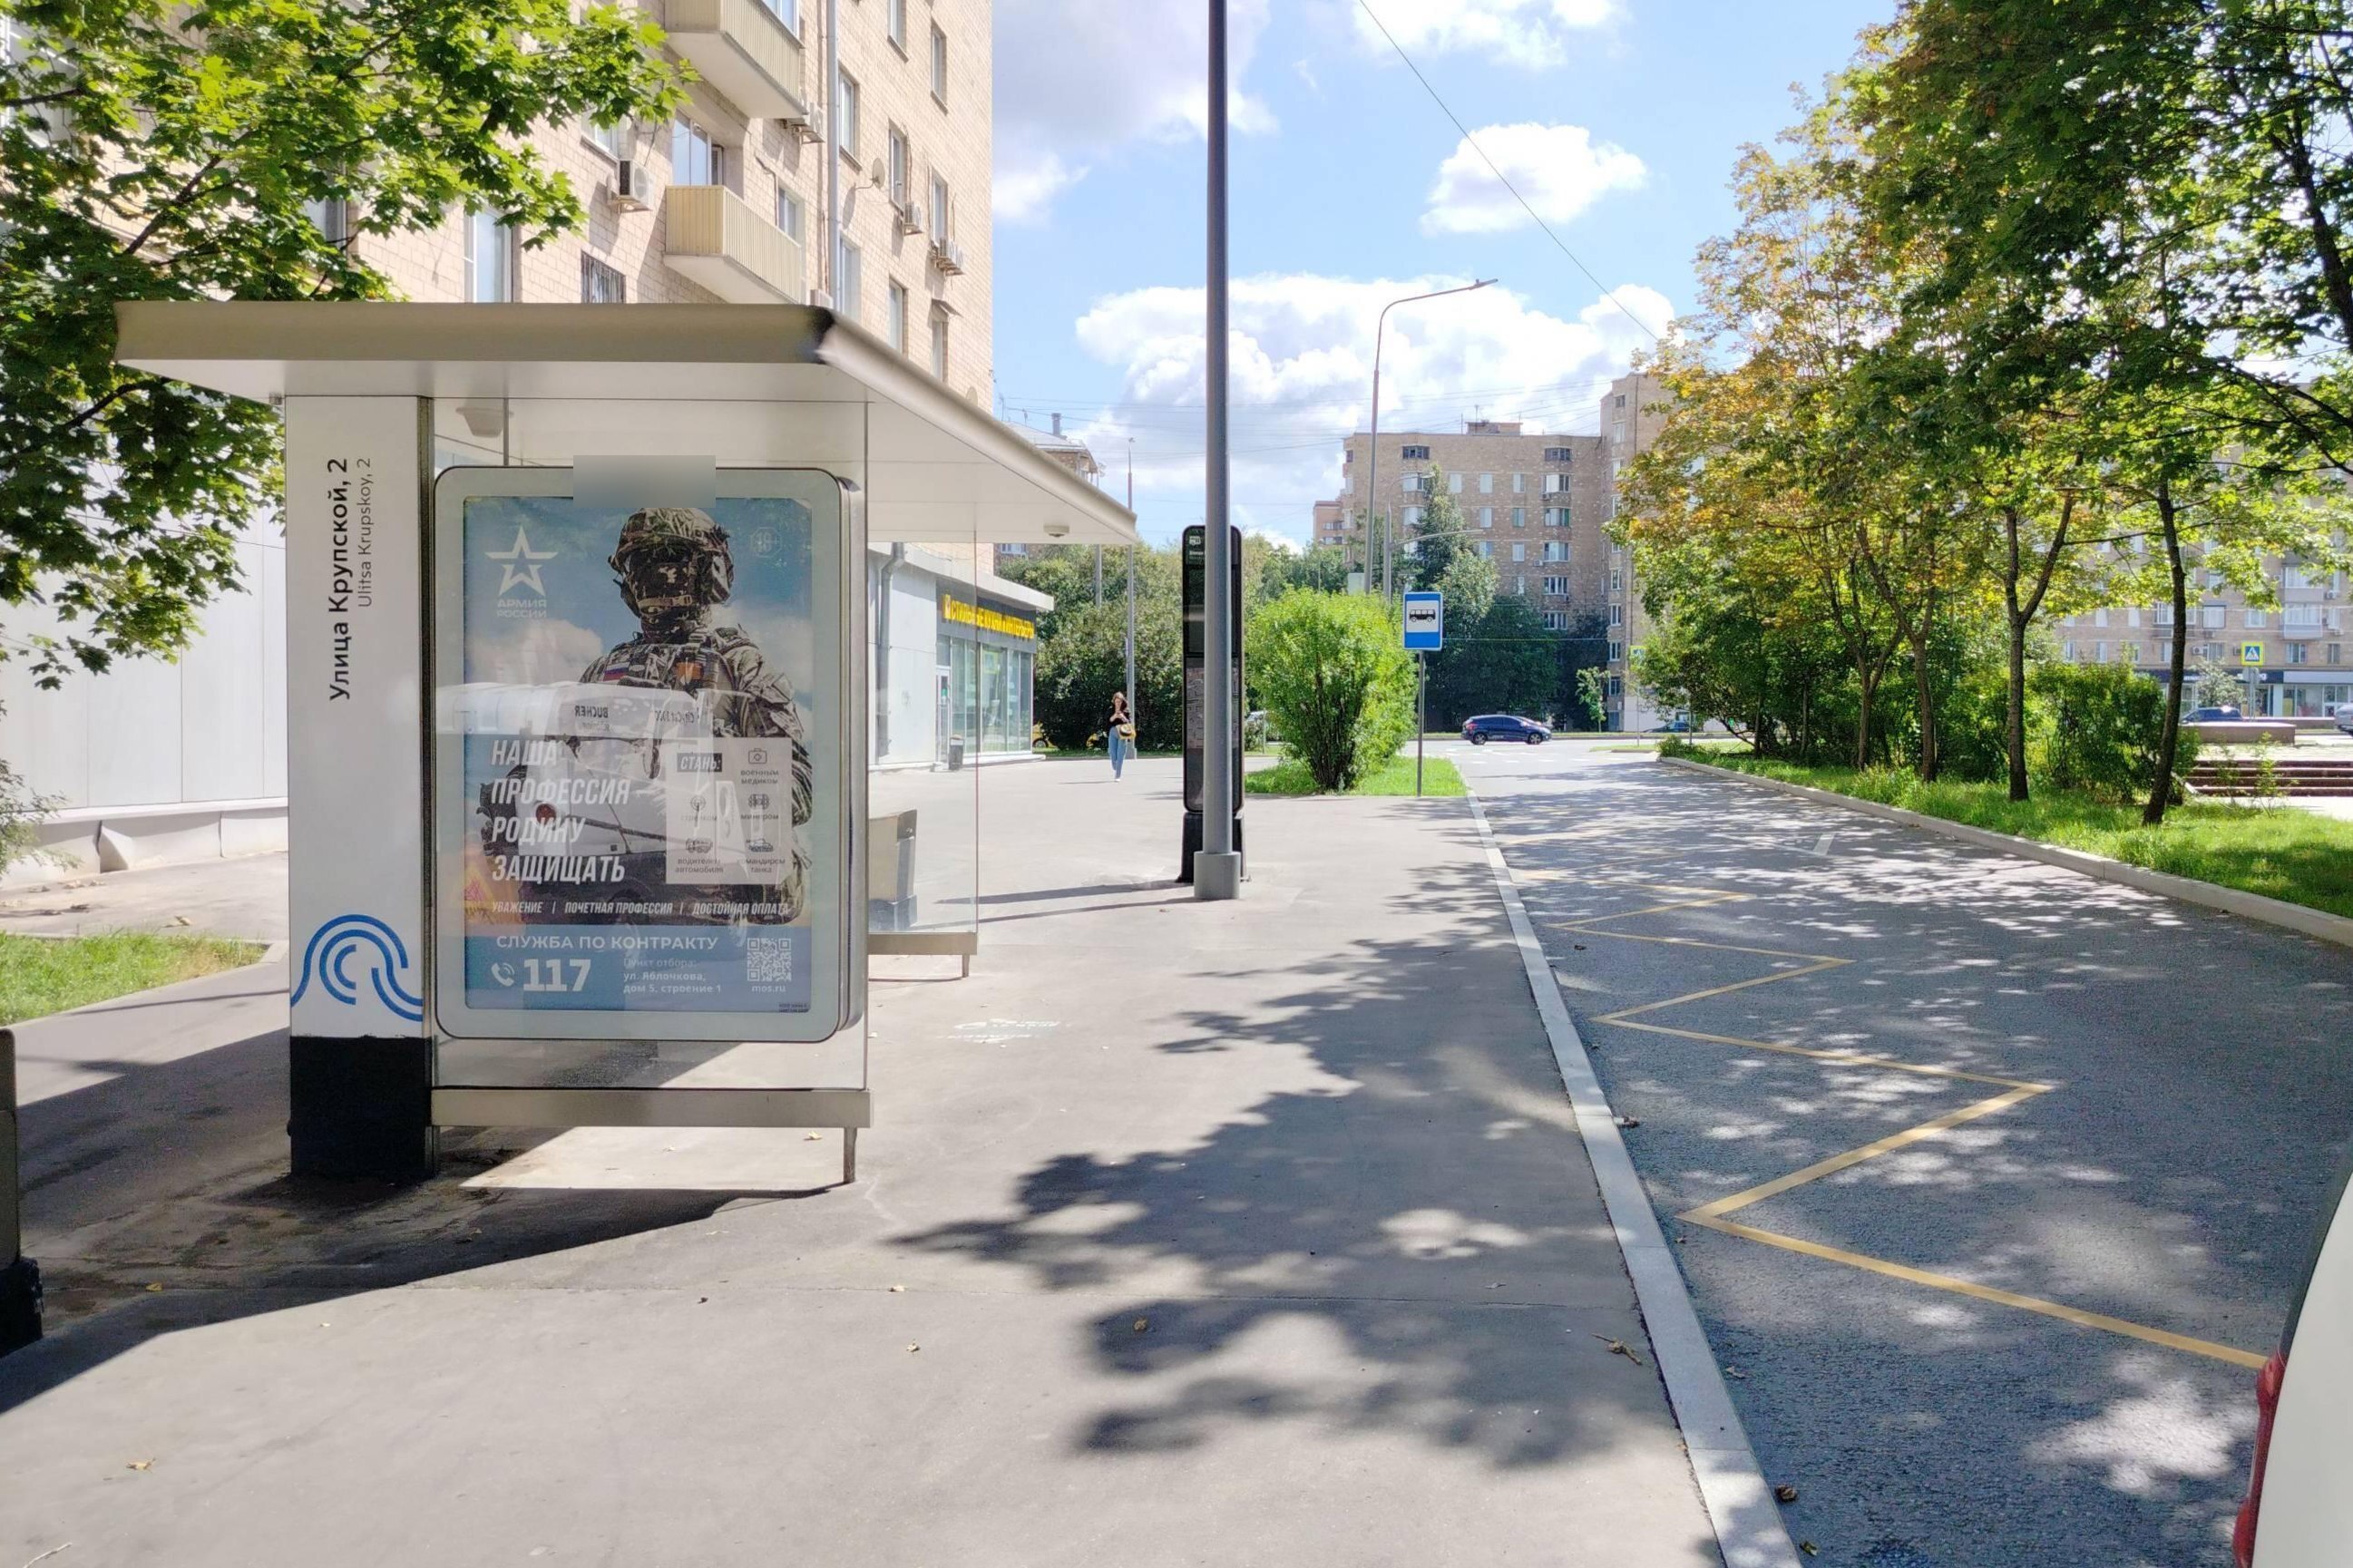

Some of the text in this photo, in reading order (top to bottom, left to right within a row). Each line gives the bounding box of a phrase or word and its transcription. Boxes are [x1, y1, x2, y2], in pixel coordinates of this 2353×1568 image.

[356, 458, 375, 608] Ulitsa Krupskoy, 2
[327, 458, 353, 700] Улица Крупской, 2
[497, 599, 547, 608] АРМИЯ
[496, 609, 547, 618] РОССИИ
[491, 739, 559, 765] НАША
[680, 755, 721, 770] СТАНЬ:
[491, 778, 631, 804] ПРОФЕССИЯ
[492, 816, 586, 846] РОДИНУ
[493, 855, 626, 884] ЗАЩИЩАТЬ
[492, 901, 543, 913] УВАЖЕНИЕ
[564, 901, 673, 914] ПОЧЕТНАЯ ПРОФЕССИЯ
[691, 902, 789, 915] ДОСТОЙНАЯ ОПЛАТА
[496, 936, 718, 950] СЛУЖБА ПО КОНТРАКТУ
[522, 959, 591, 992] 117
[623, 971, 706, 983] ул. Яблочкова,
[623, 985, 646, 994] дом
[660, 985, 713, 995] строение
[716, 984, 721, 993] 1
[751, 984, 786, 993] mos.ru
